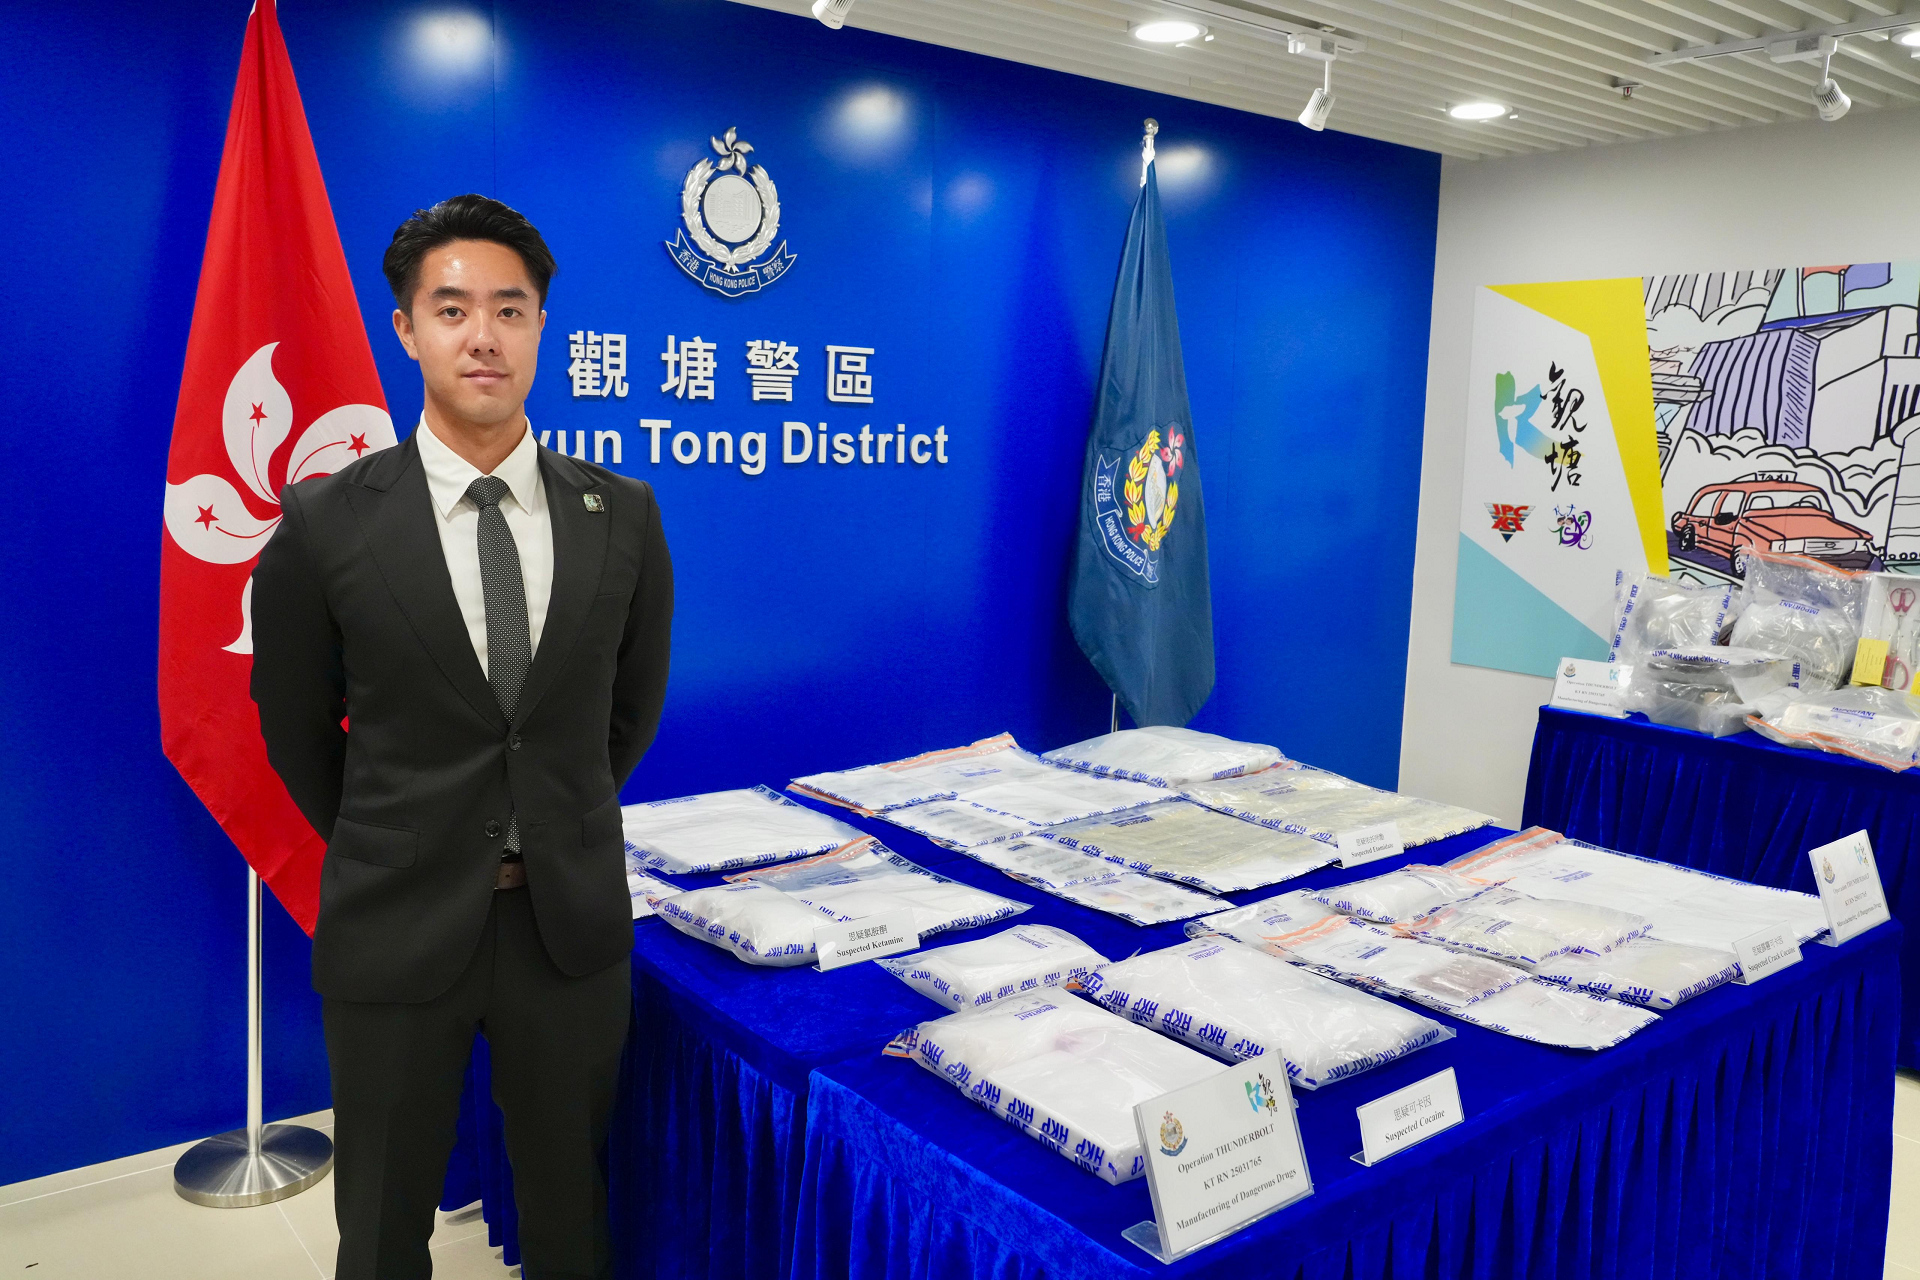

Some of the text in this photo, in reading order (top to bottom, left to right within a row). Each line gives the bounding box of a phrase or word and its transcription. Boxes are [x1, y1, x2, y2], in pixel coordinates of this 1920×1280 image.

[678, 249, 700, 273] 香港
[709, 272, 756, 288] HONG KONG POLICE
[568, 331, 875, 404] 觀塘警區
[640, 419, 767, 475] Tong
[783, 421, 949, 464] District
[1105, 516, 1146, 567] HONG KONG POLICE
[1212, 765, 1246, 780] IMPORTANT
[836, 936, 904, 957] Suspected Ketamine
[1131, 998, 1160, 1019] HKP
[1162, 1008, 1193, 1032] HKP
[1197, 1023, 1228, 1047] HKP
[920, 1039, 945, 1065] HKP
[971, 1079, 1001, 1104] HKP
[1007, 1097, 1035, 1124] HKP
[1041, 1117, 1069, 1145] HKP
[1075, 1138, 1105, 1166] HKP
[1393, 1094, 1432, 1122] 思疑可卡因
[1385, 1110, 1445, 1143] Suspected Cocaine
[1177, 1152, 1214, 1174] Operation
[1214, 1123, 1275, 1157] THUNDERBOLT
[1203, 1156, 1263, 1191] KT RN 25031765
[1176, 1168, 1297, 1231] Manufacturing of Dangerous Drugs
